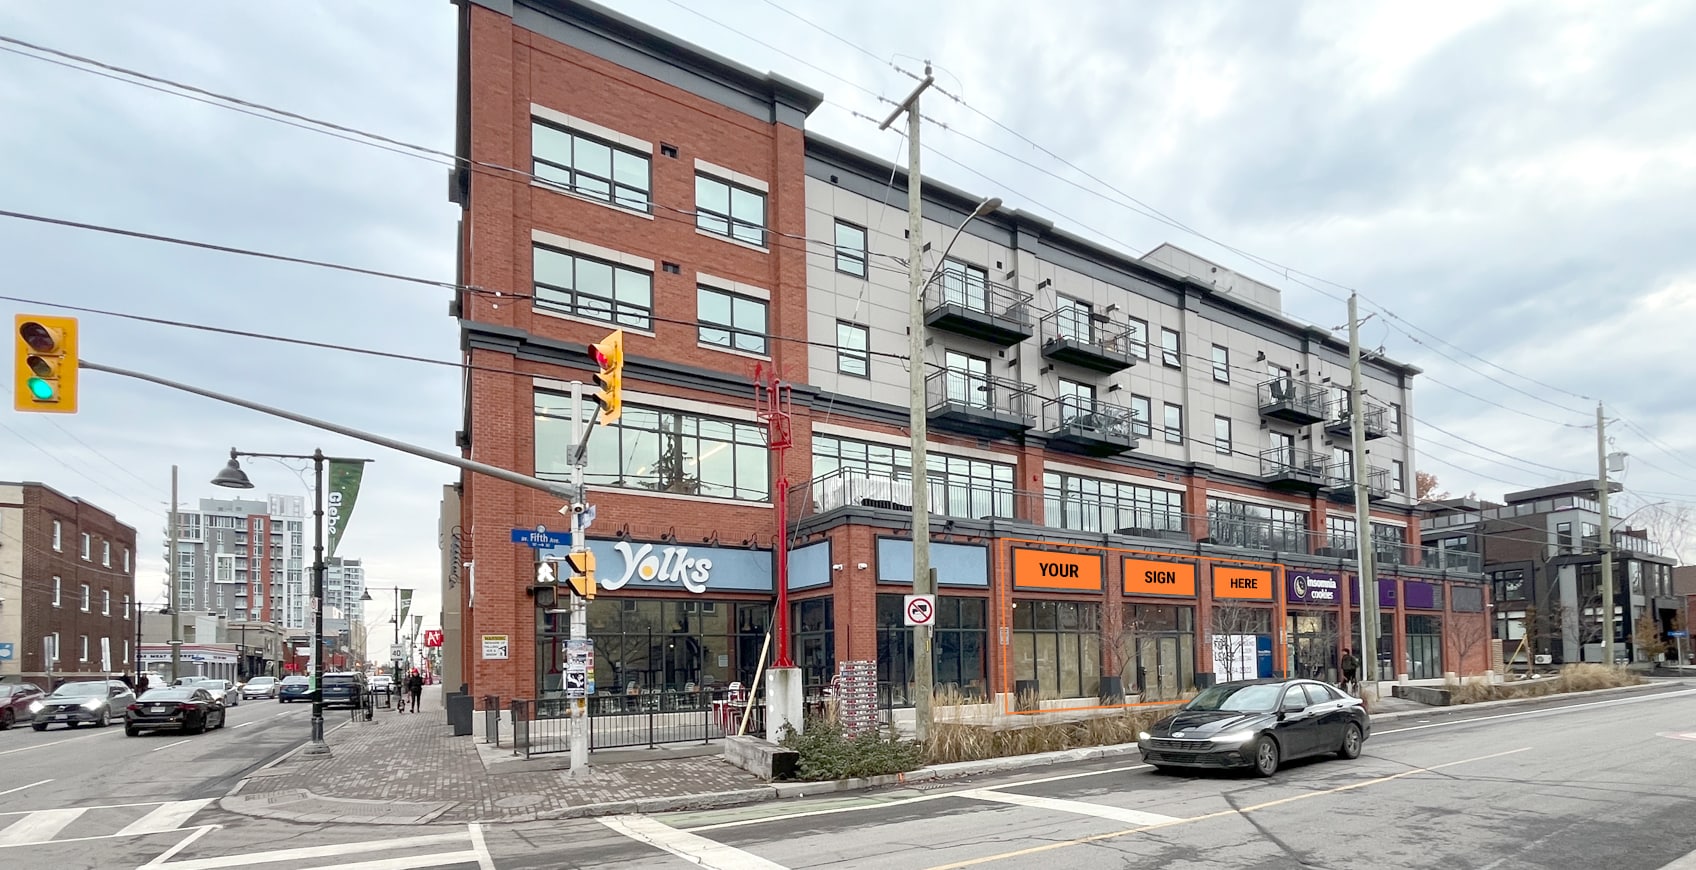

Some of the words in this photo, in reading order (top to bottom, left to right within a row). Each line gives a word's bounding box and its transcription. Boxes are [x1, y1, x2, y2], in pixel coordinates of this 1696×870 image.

[328, 491, 342, 535] Glebe
[530, 532, 548, 543] Fifth
[601, 541, 712, 593] Yolks
[1306, 575, 1337, 588] insomnia
[1311, 589, 1334, 599] cookies
[392, 649, 401, 657] 40
